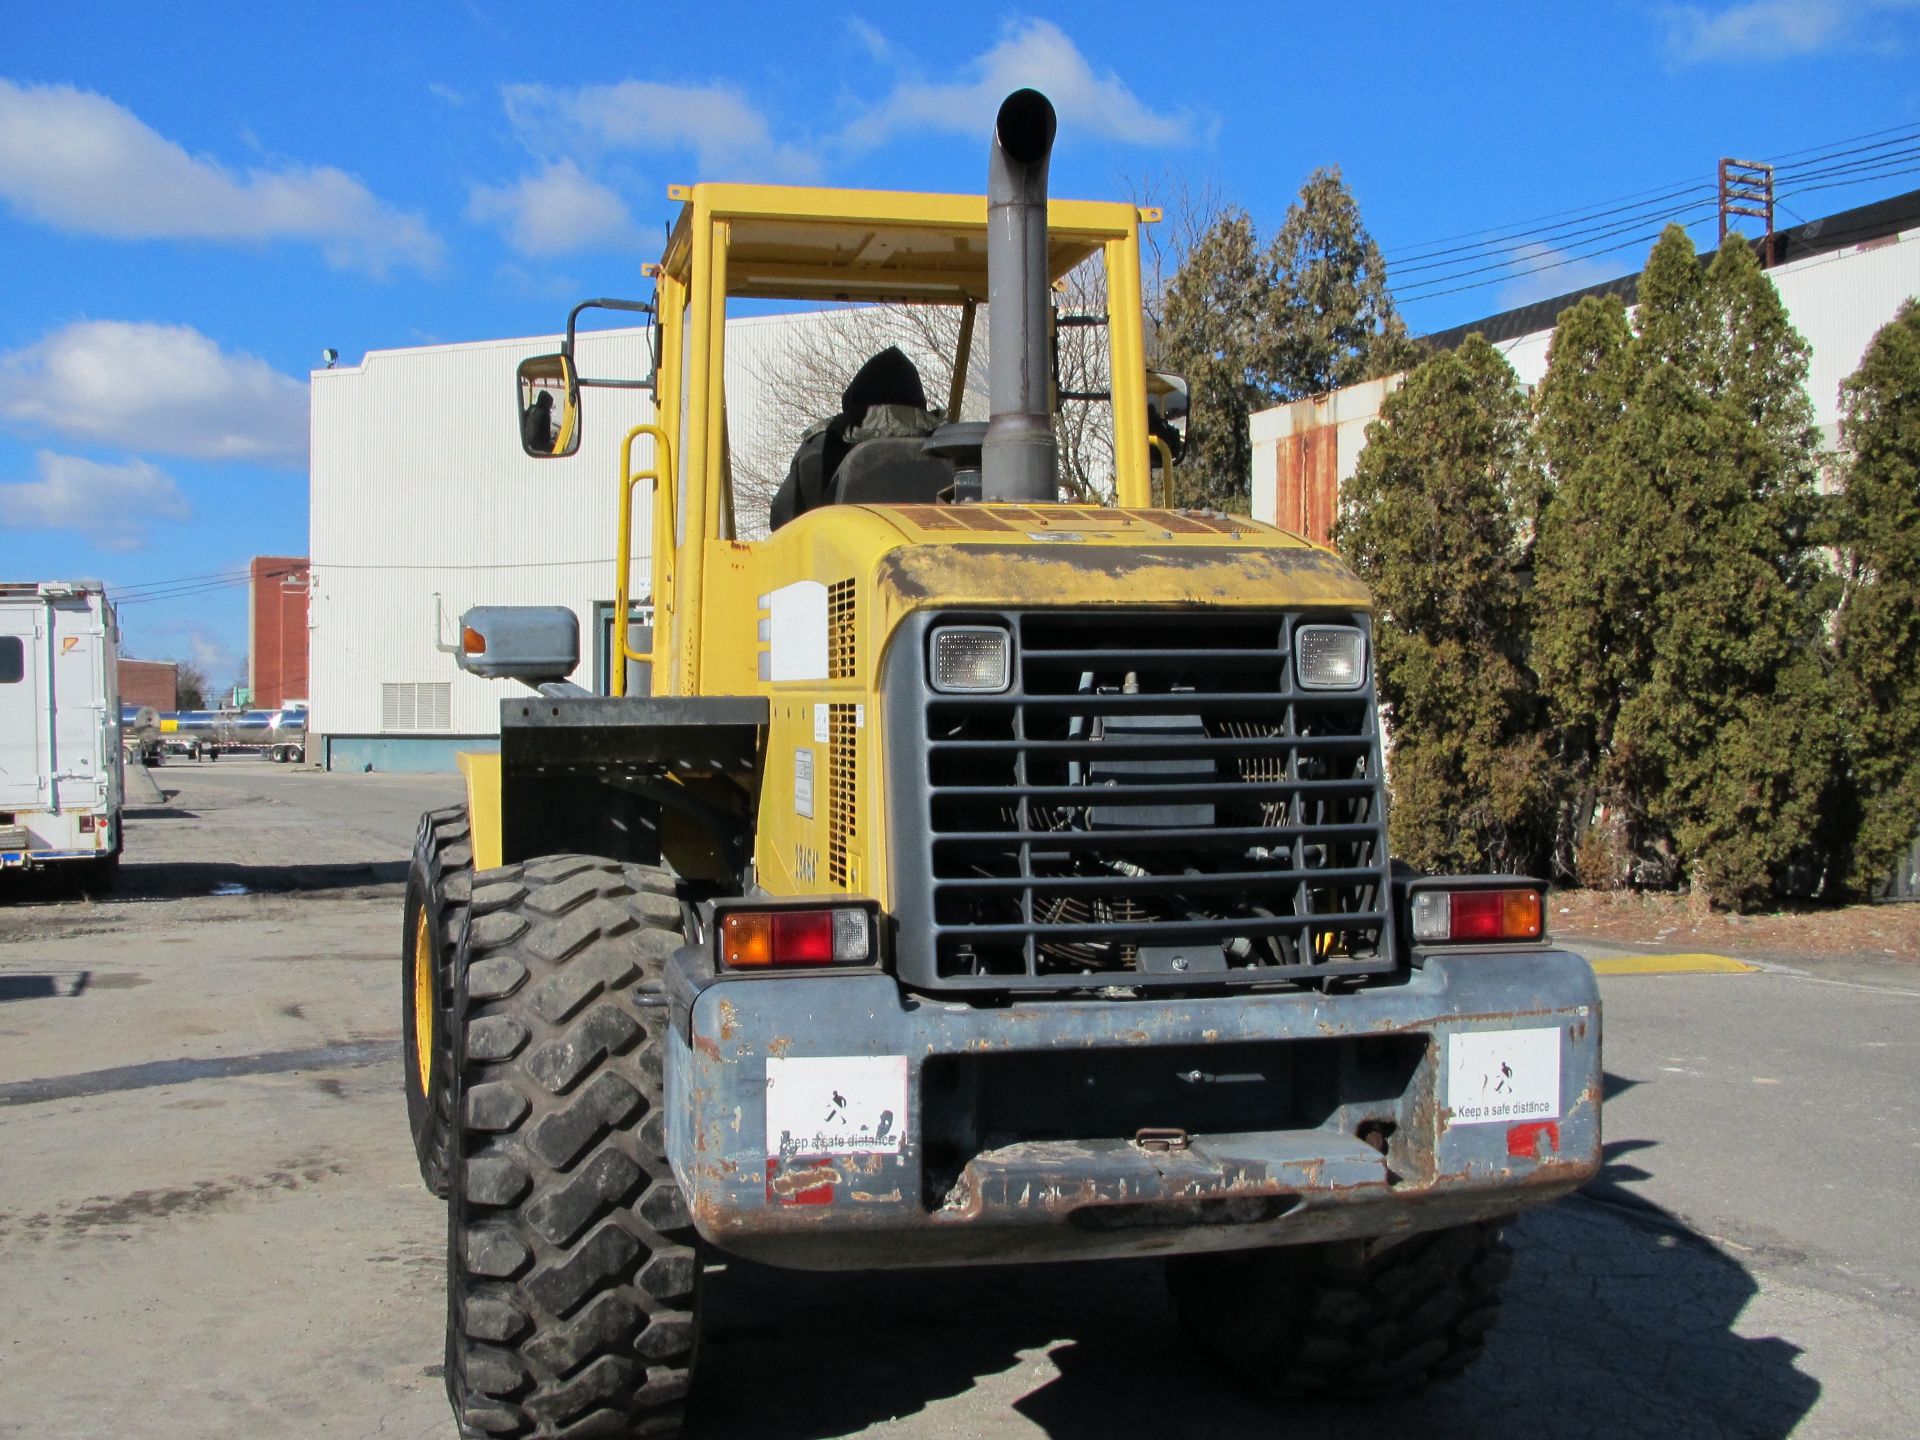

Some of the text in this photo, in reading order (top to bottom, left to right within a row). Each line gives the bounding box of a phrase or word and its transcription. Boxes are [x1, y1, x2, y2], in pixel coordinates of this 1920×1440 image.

[1458, 1101, 1550, 1120] Keep a safe distance
